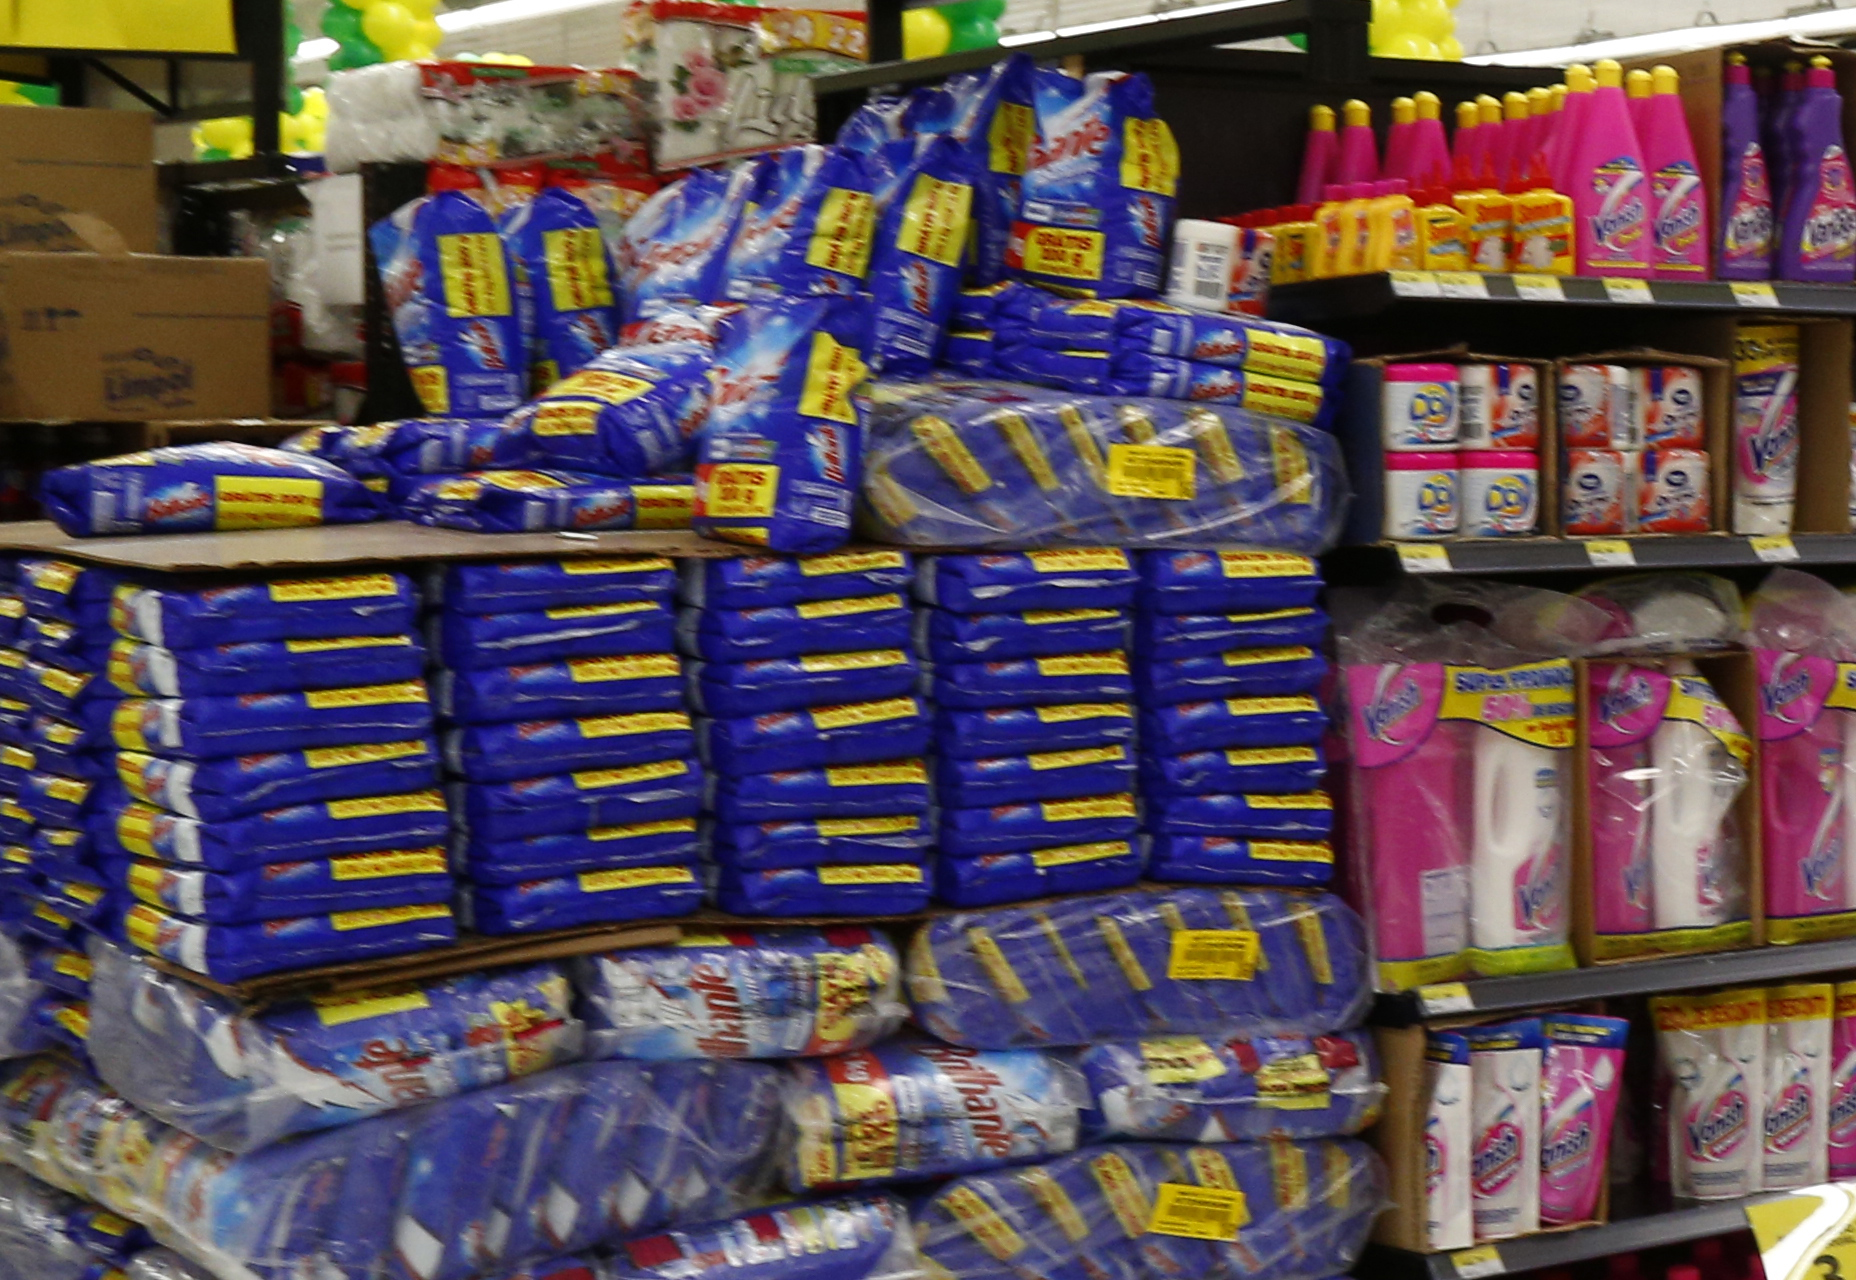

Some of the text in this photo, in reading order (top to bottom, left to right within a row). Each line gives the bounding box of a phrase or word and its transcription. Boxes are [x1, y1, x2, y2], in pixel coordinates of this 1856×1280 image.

[1765, 1090, 1813, 1136] anish
[1474, 1124, 1522, 1181] anish
[1543, 1122, 1591, 1170] anish
